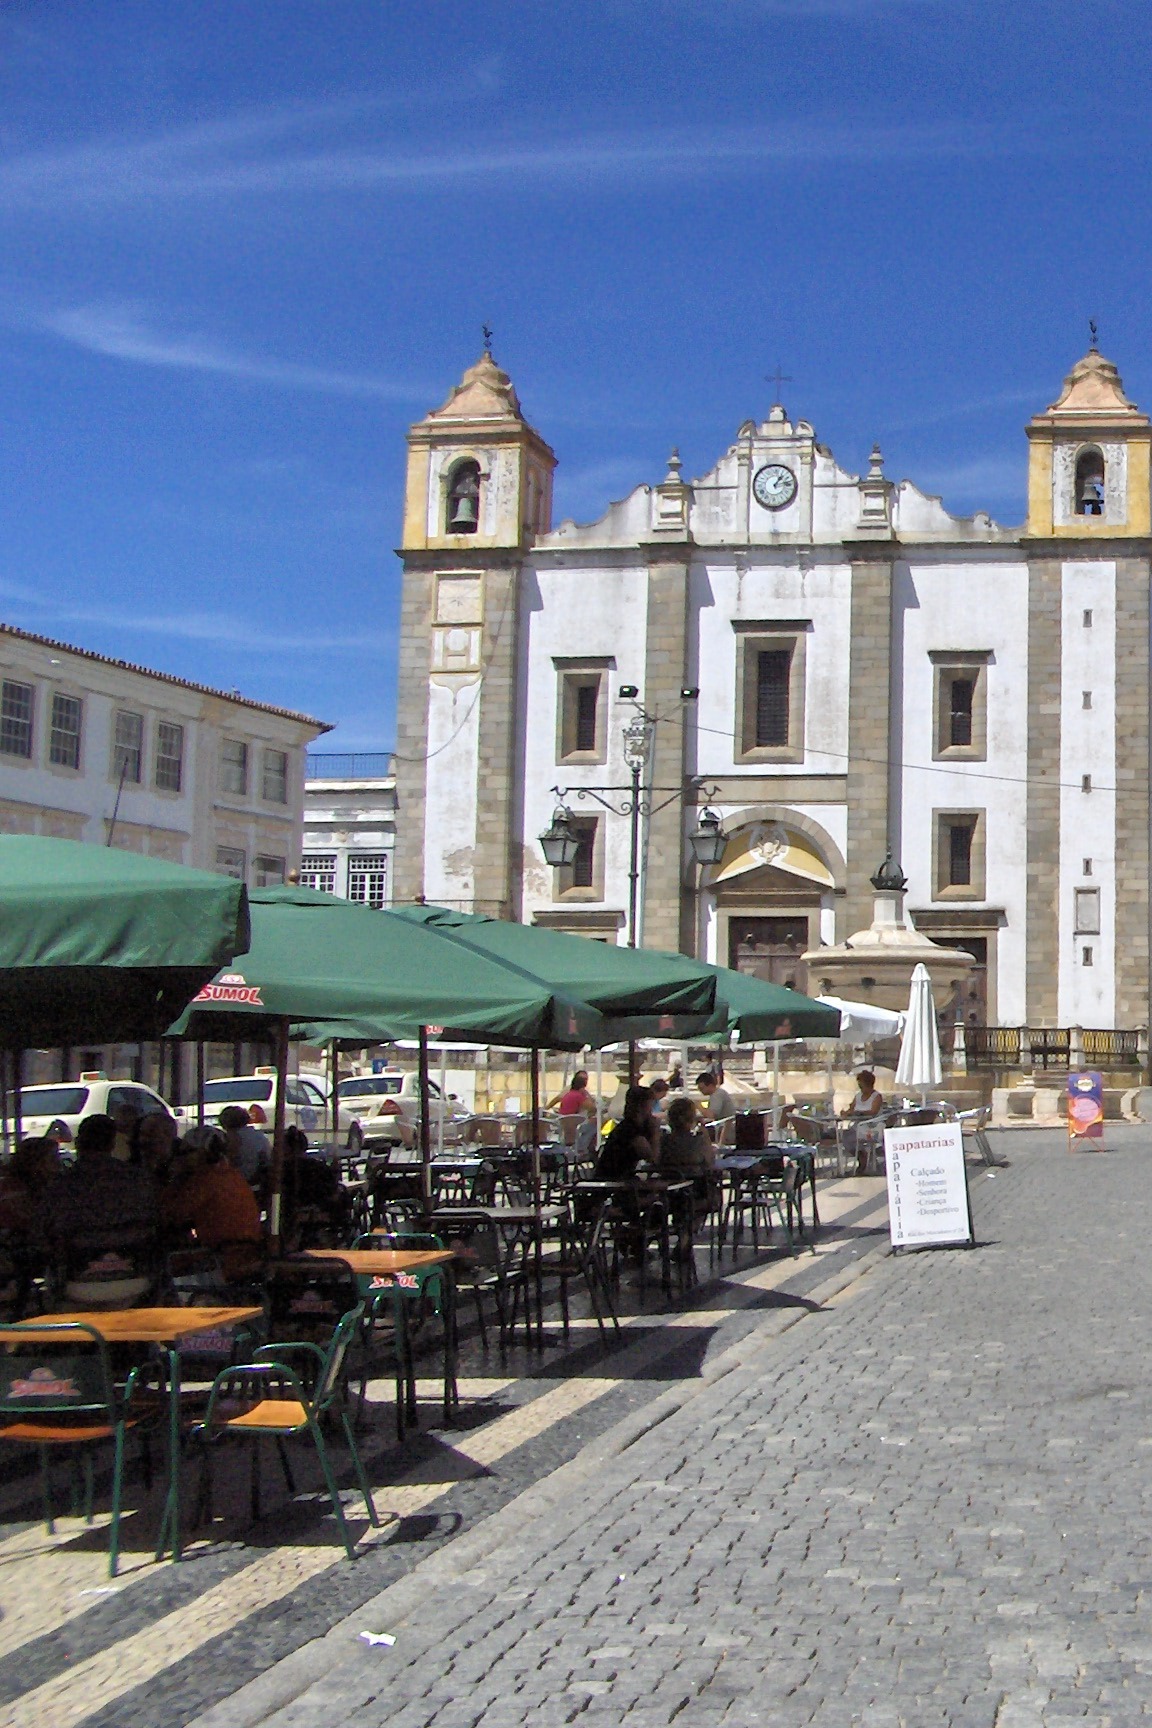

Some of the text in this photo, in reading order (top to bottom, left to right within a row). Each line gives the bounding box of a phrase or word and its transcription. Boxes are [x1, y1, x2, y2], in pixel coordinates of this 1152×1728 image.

[196, 985, 262, 1004] SUMOL
[892, 1137, 955, 1152] sapatarias
[910, 1166, 945, 1177] Calçado
